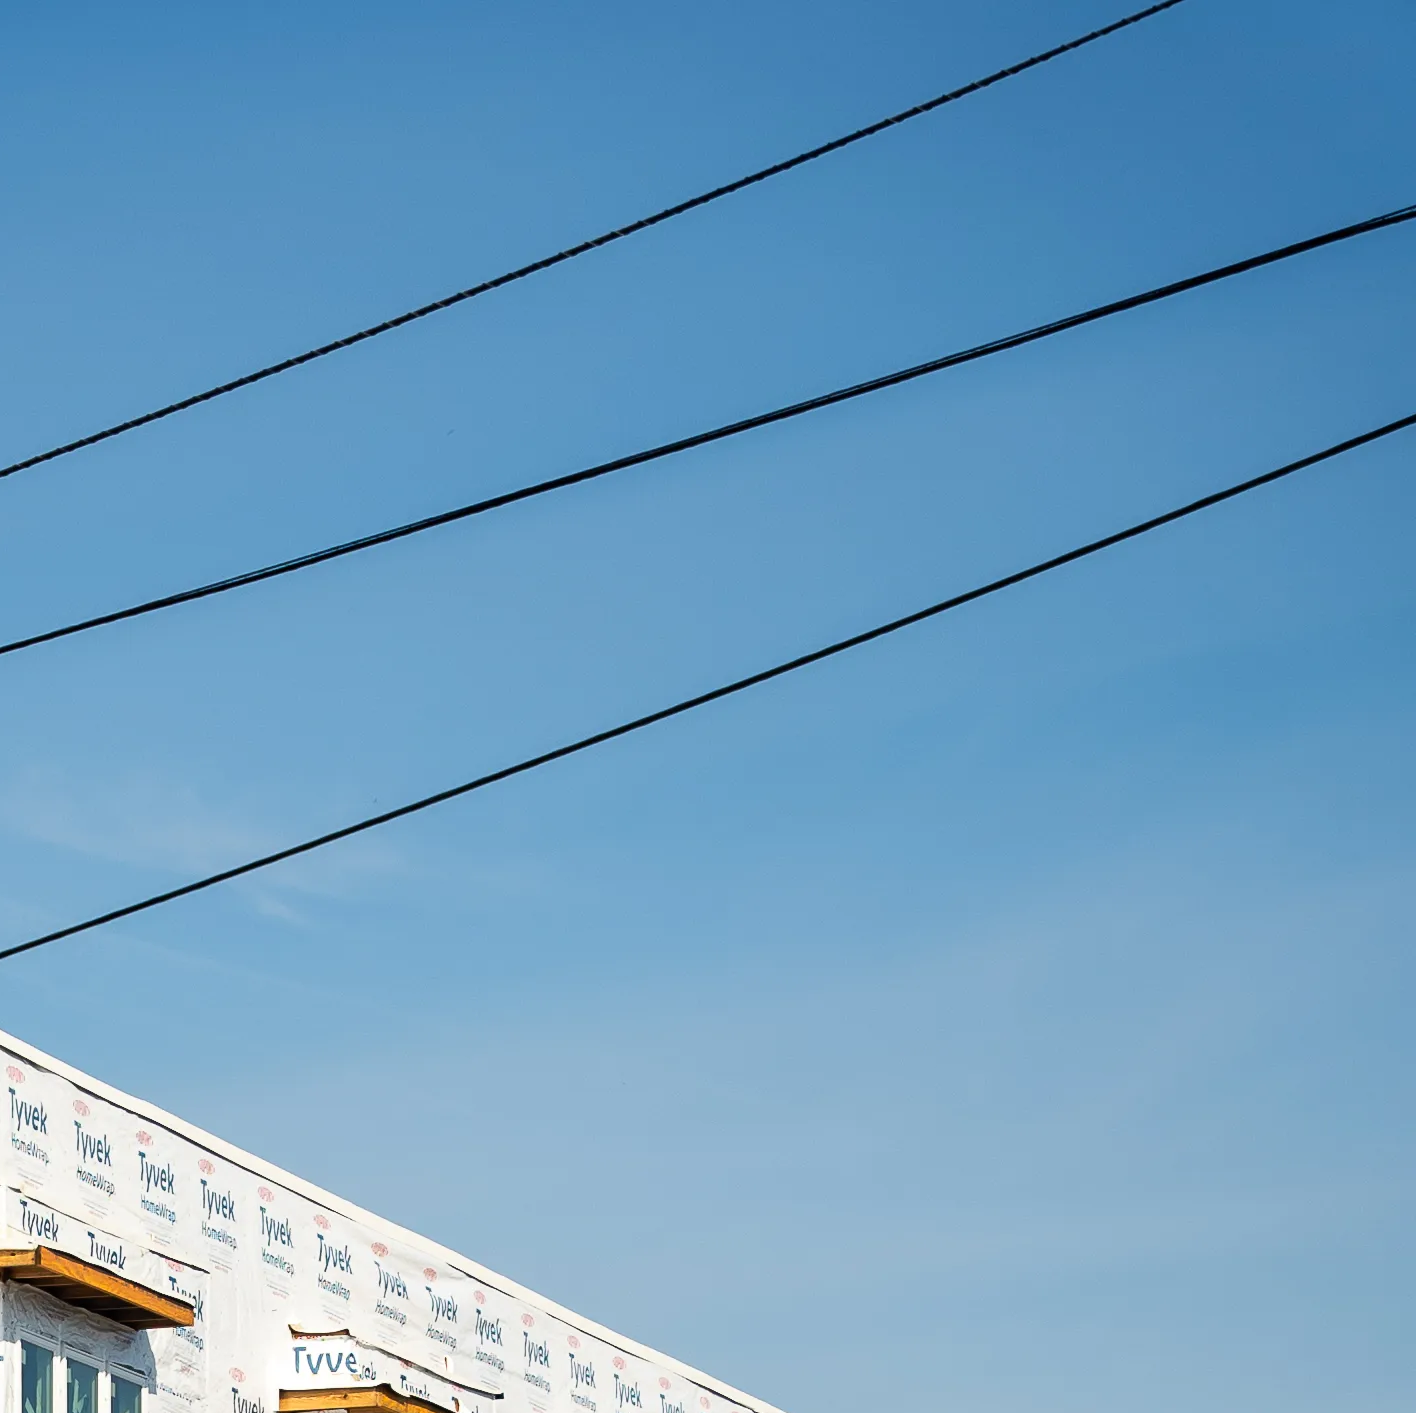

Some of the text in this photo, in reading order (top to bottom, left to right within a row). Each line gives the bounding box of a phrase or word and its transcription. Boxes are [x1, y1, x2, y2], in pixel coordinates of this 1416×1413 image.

[9, 1088, 47, 1134] Tyvek
[12, 1133, 49, 1165] HomeWrap
[74, 1121, 111, 1167] Tyvek
[77, 1166, 115, 1197] HomeWrap
[139, 1152, 175, 1195] Tyvek
[141, 1195, 176, 1225] HomeWrap
[201, 1179, 235, 1222] Tyvek
[20, 1200, 59, 1242] Tyvek
[202, 1221, 237, 1250] HomeWrap
[260, 1206, 294, 1248] Tyvek
[262, 1247, 294, 1276] HomeWrap
[317, 1233, 352, 1274] Tyvek
[318, 1273, 350, 1300] HomeWrap
[375, 1261, 408, 1299] Tyvek
[375, 1299, 406, 1326] HomeWrap
[426, 1286, 458, 1323] Tyvek
[425, 1323, 457, 1351] HomeWrap
[475, 1309, 503, 1346] Tyvek
[476, 1347, 504, 1373] HomeWrap
[523, 1331, 549, 1367] Tyvek
[524, 1368, 551, 1393] HomeWrap
[569, 1353, 596, 1388] Tyvek
[614, 1374, 642, 1408] Tyvek
